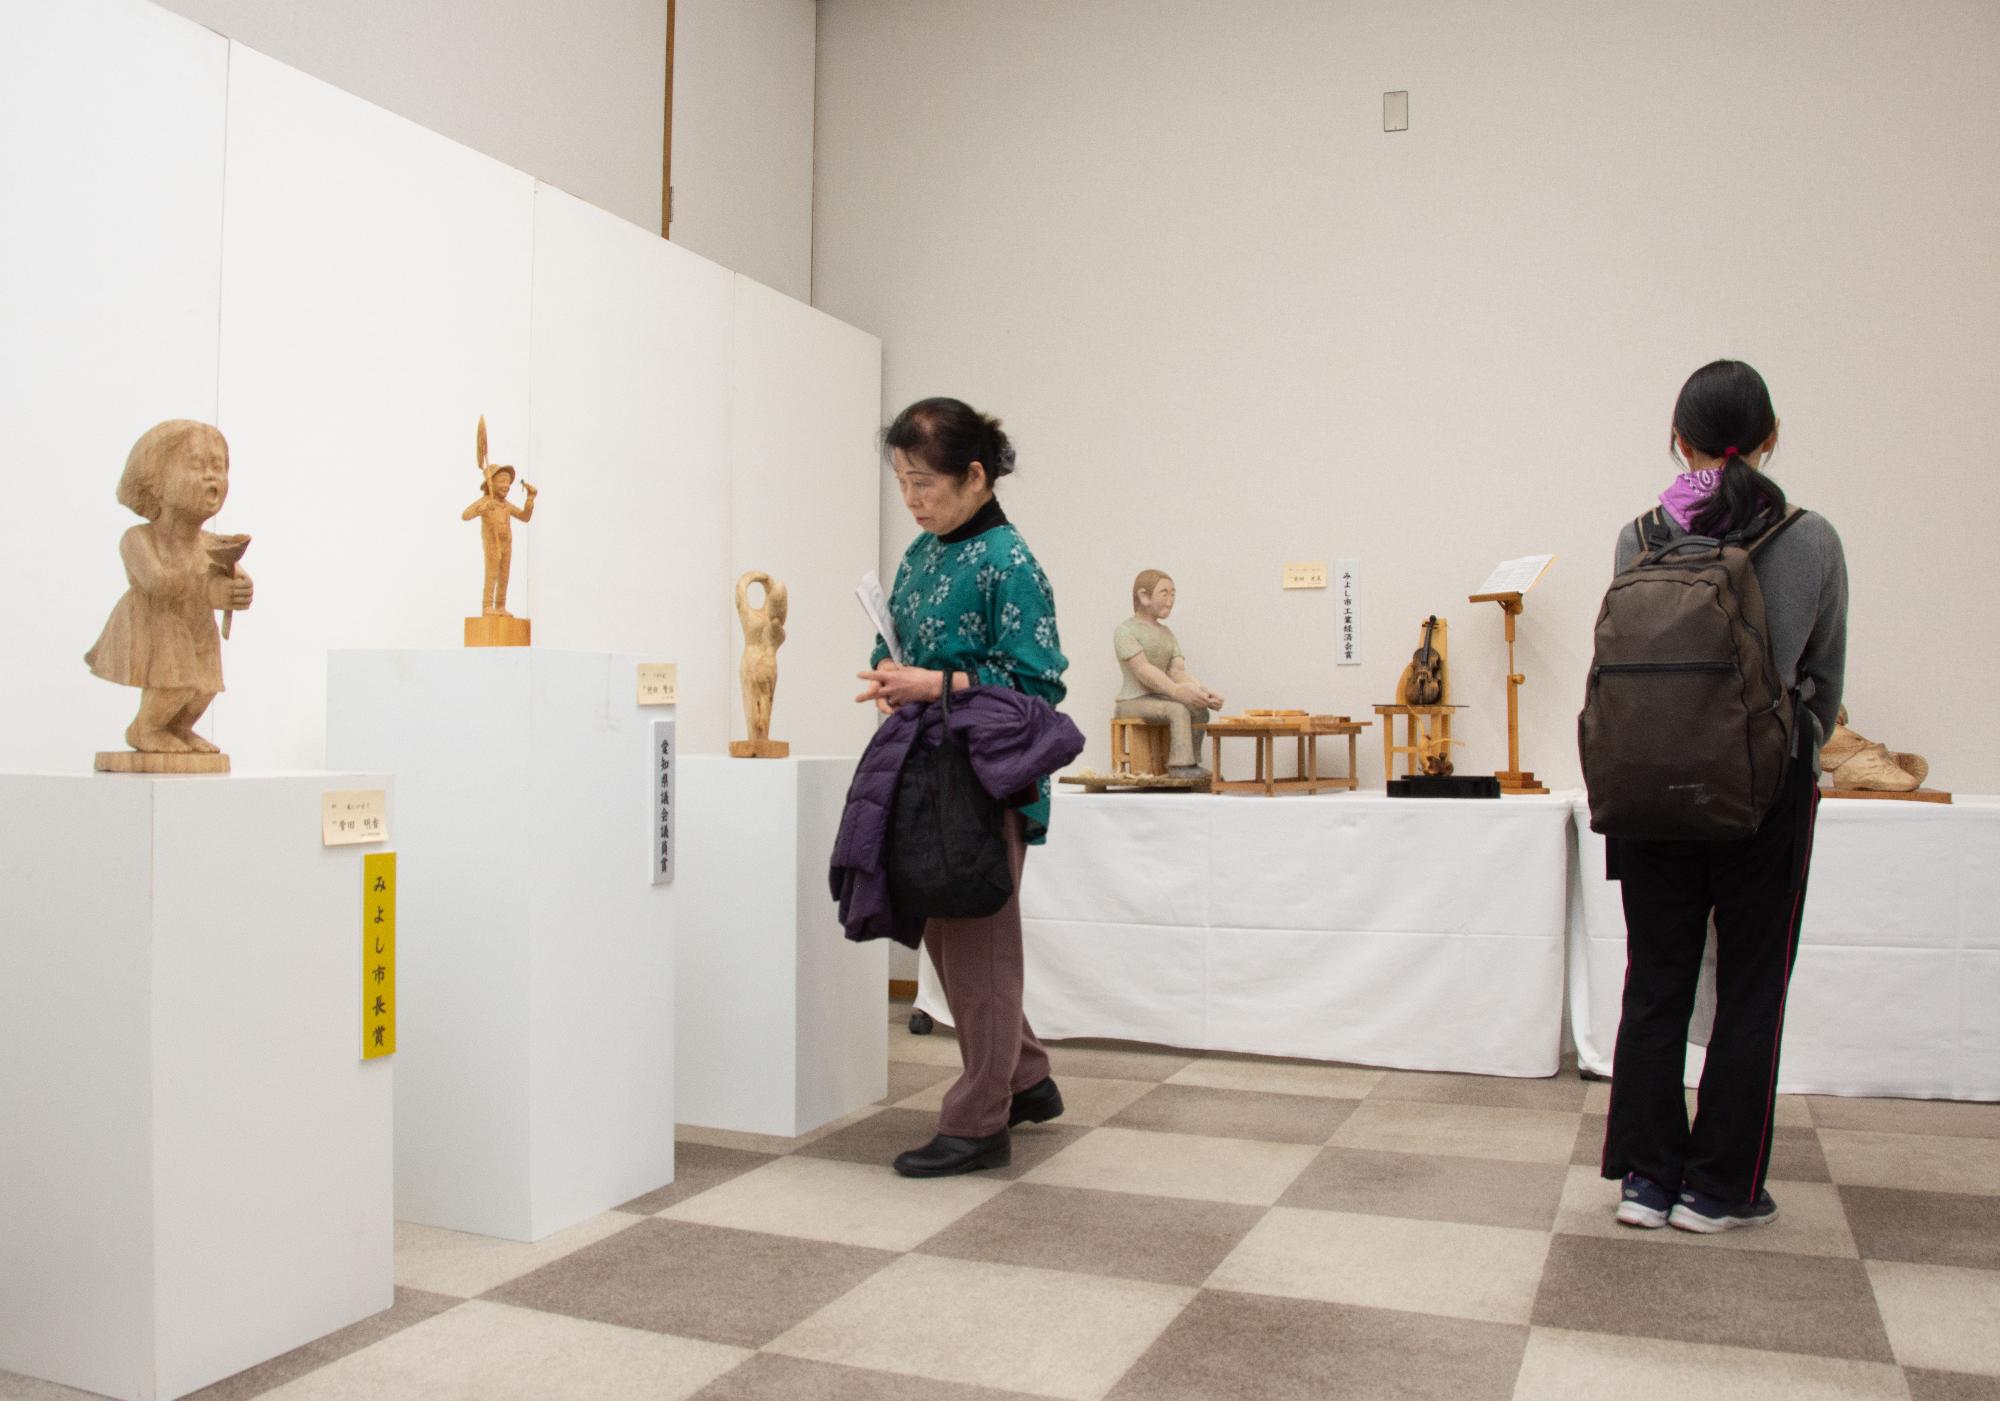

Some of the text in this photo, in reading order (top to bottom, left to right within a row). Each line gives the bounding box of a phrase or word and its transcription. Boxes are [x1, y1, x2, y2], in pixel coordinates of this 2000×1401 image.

[660, 739, 669, 873] 愛知県議会議員賞
[372, 876, 386, 1046] みよし市長賞
